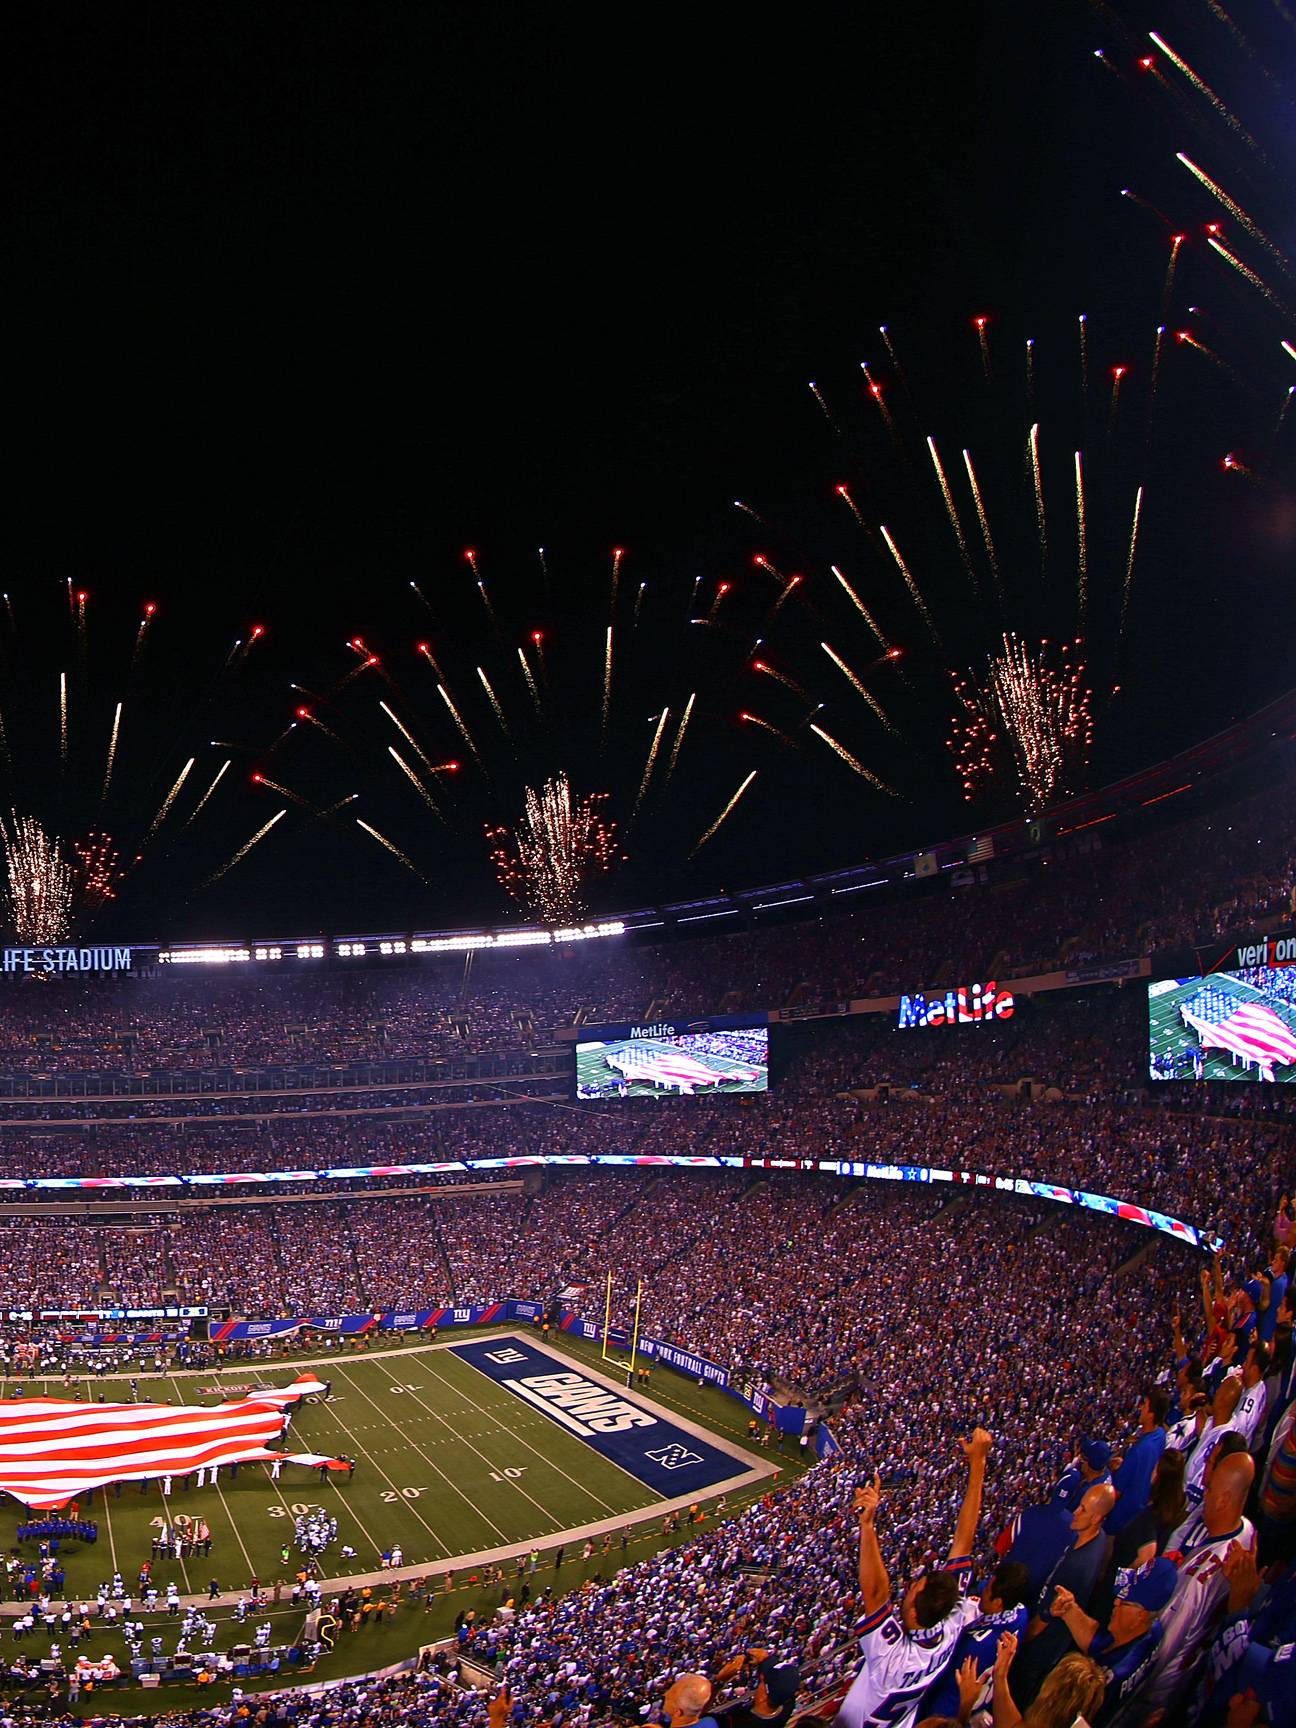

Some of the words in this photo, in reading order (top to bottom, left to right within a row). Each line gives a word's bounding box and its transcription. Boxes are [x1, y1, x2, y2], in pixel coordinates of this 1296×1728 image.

[42, 948, 132, 971] STADIUM
[1238, 936, 1296, 968] verizon
[898, 980, 1014, 1029] MetLife
[630, 1024, 676, 1039] MetLife
[639, 1338, 654, 1354] NEW
[672, 1351, 702, 1375] FOOTBALL
[518, 1372, 659, 1434] GIANTS
[1239, 1397, 1255, 1414] 19
[488, 1467, 524, 1483] 10
[379, 1487, 422, 1503] 20
[266, 1503, 310, 1518] 30
